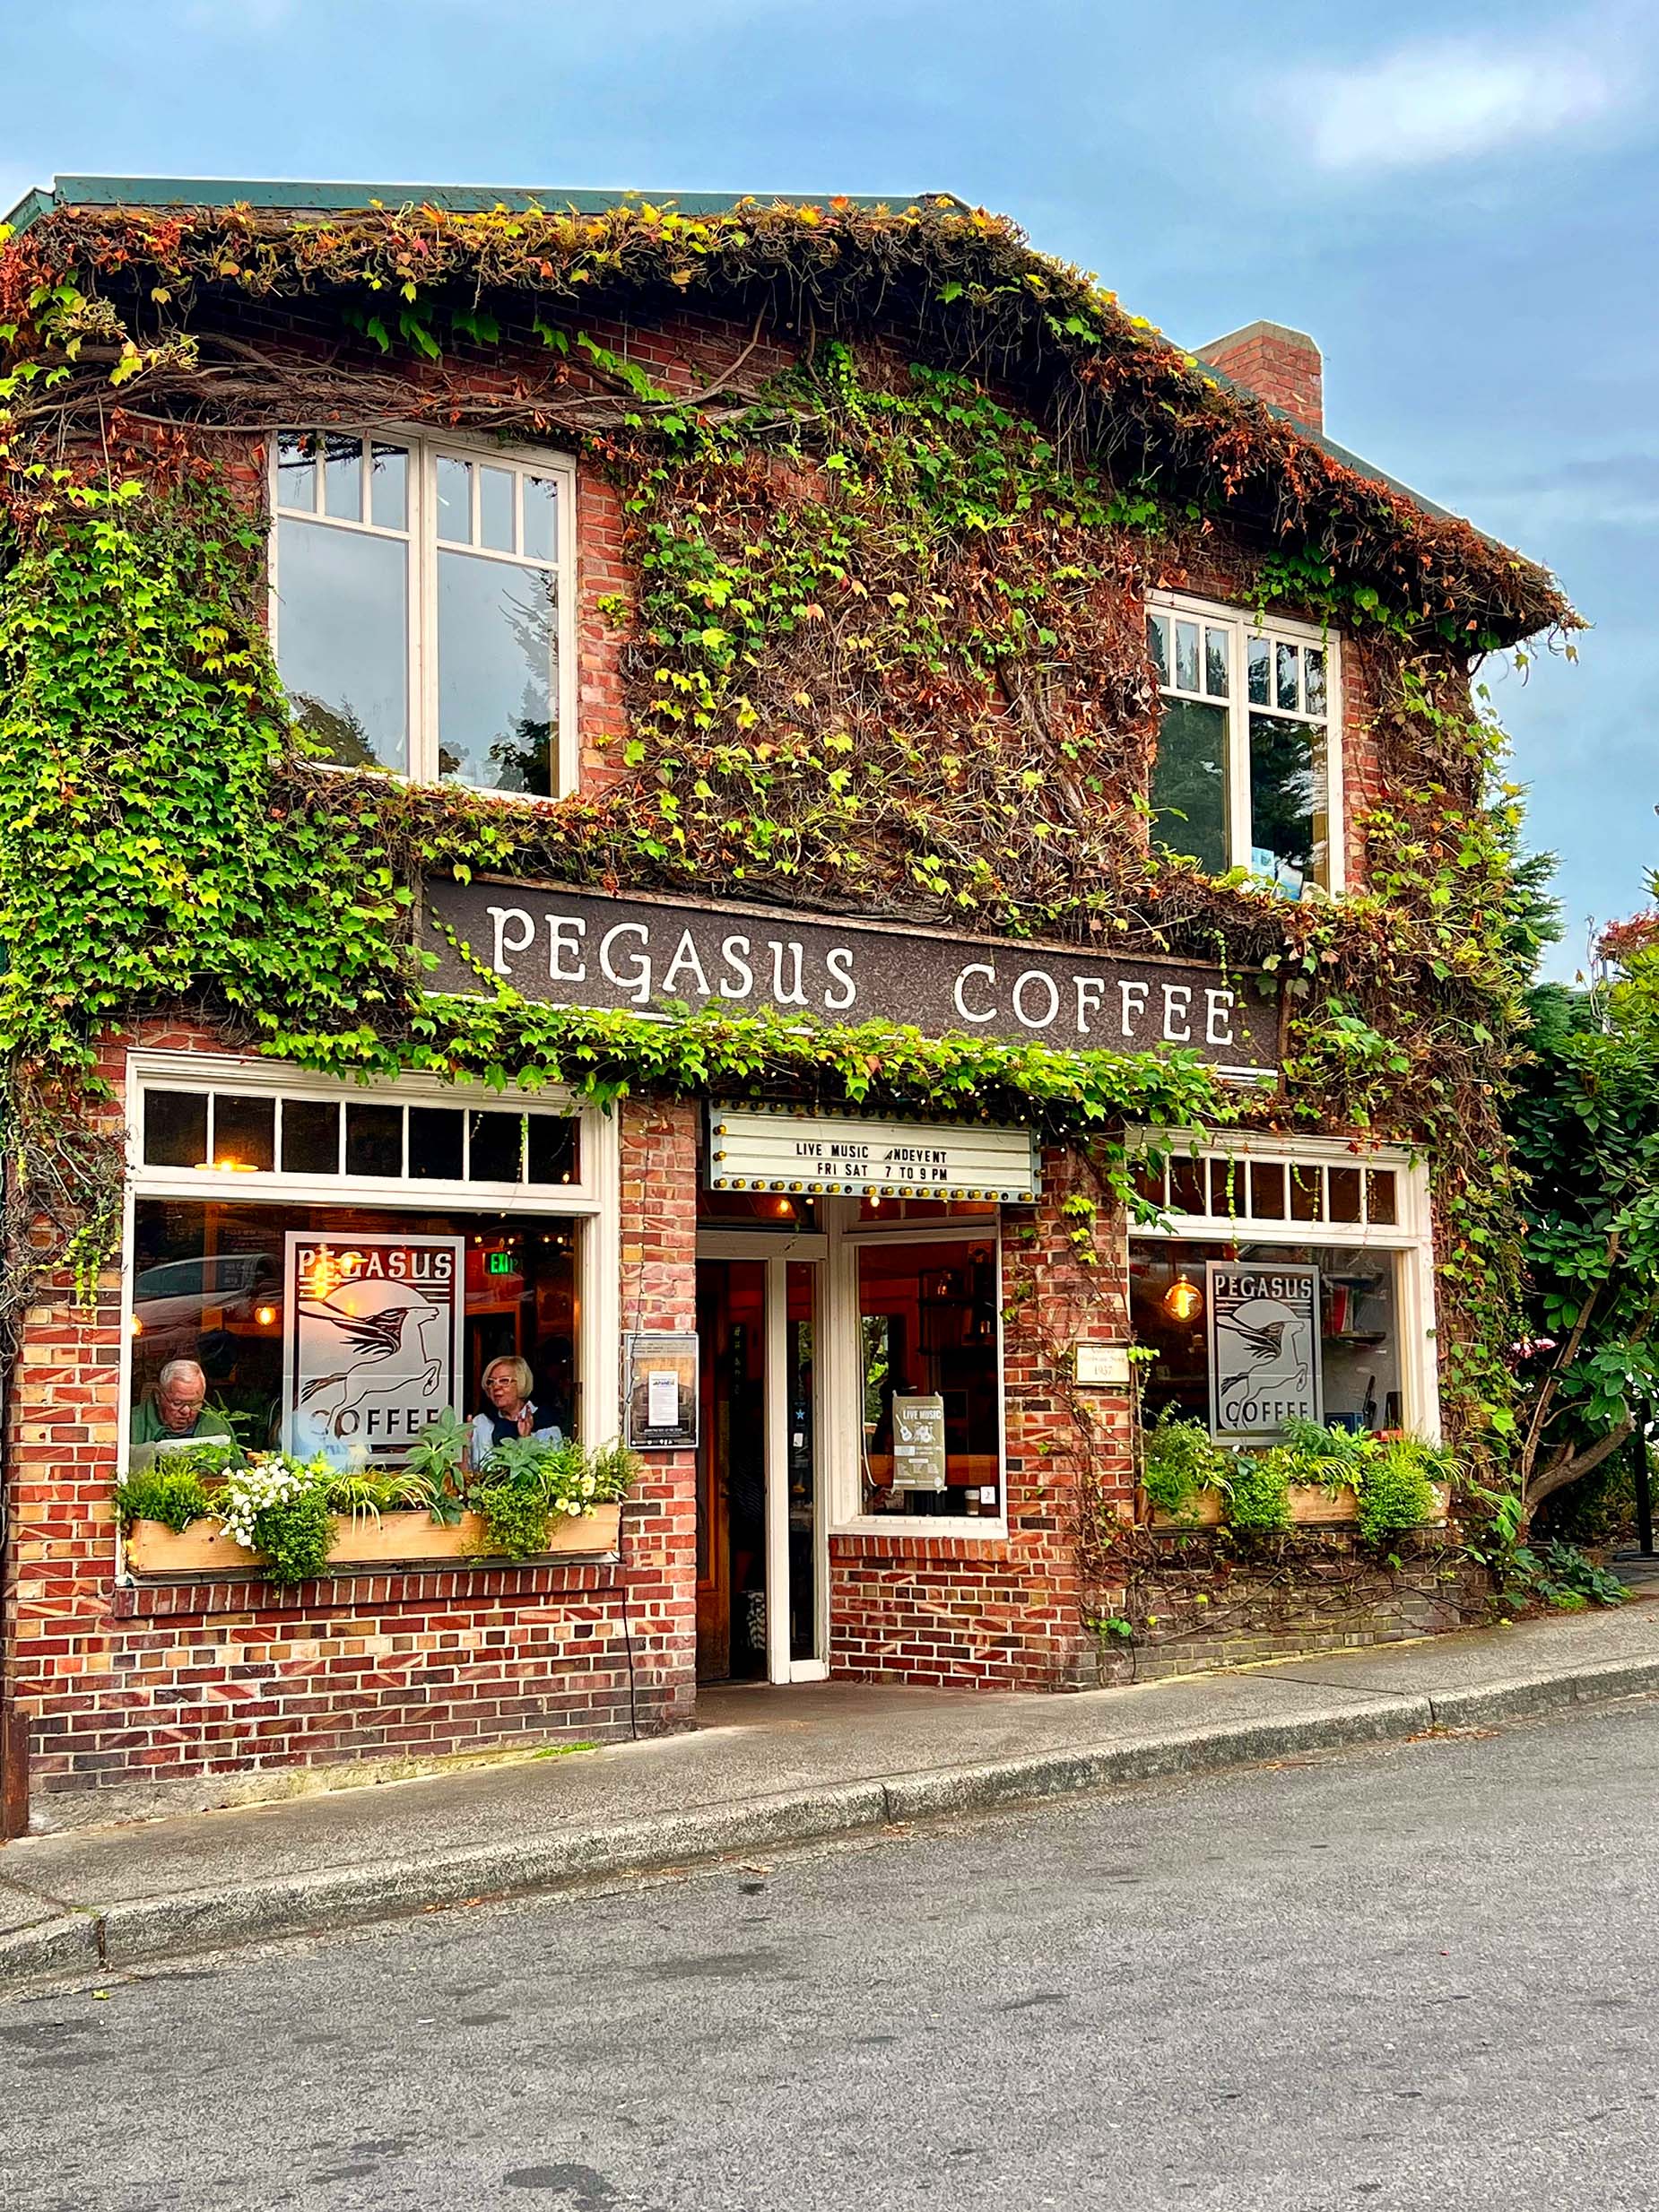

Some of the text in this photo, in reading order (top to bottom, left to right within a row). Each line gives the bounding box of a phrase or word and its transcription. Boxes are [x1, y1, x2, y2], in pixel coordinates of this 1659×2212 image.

[486, 905, 1236, 1046] PEGASUS COFFEE
[795, 1142, 948, 1164] LIVE MUSIC ANDEVENT
[817, 1162, 948, 1182] FRI SAT 7 TO 9 PM
[298, 1249, 453, 1279] PEGASUS
[491, 1253, 513, 1274] EXI
[1214, 1274, 1313, 1299] PEGASUS
[902, 1410, 942, 1420] LIVE MUSIC
[1226, 1401, 1308, 1423] COFFEE
